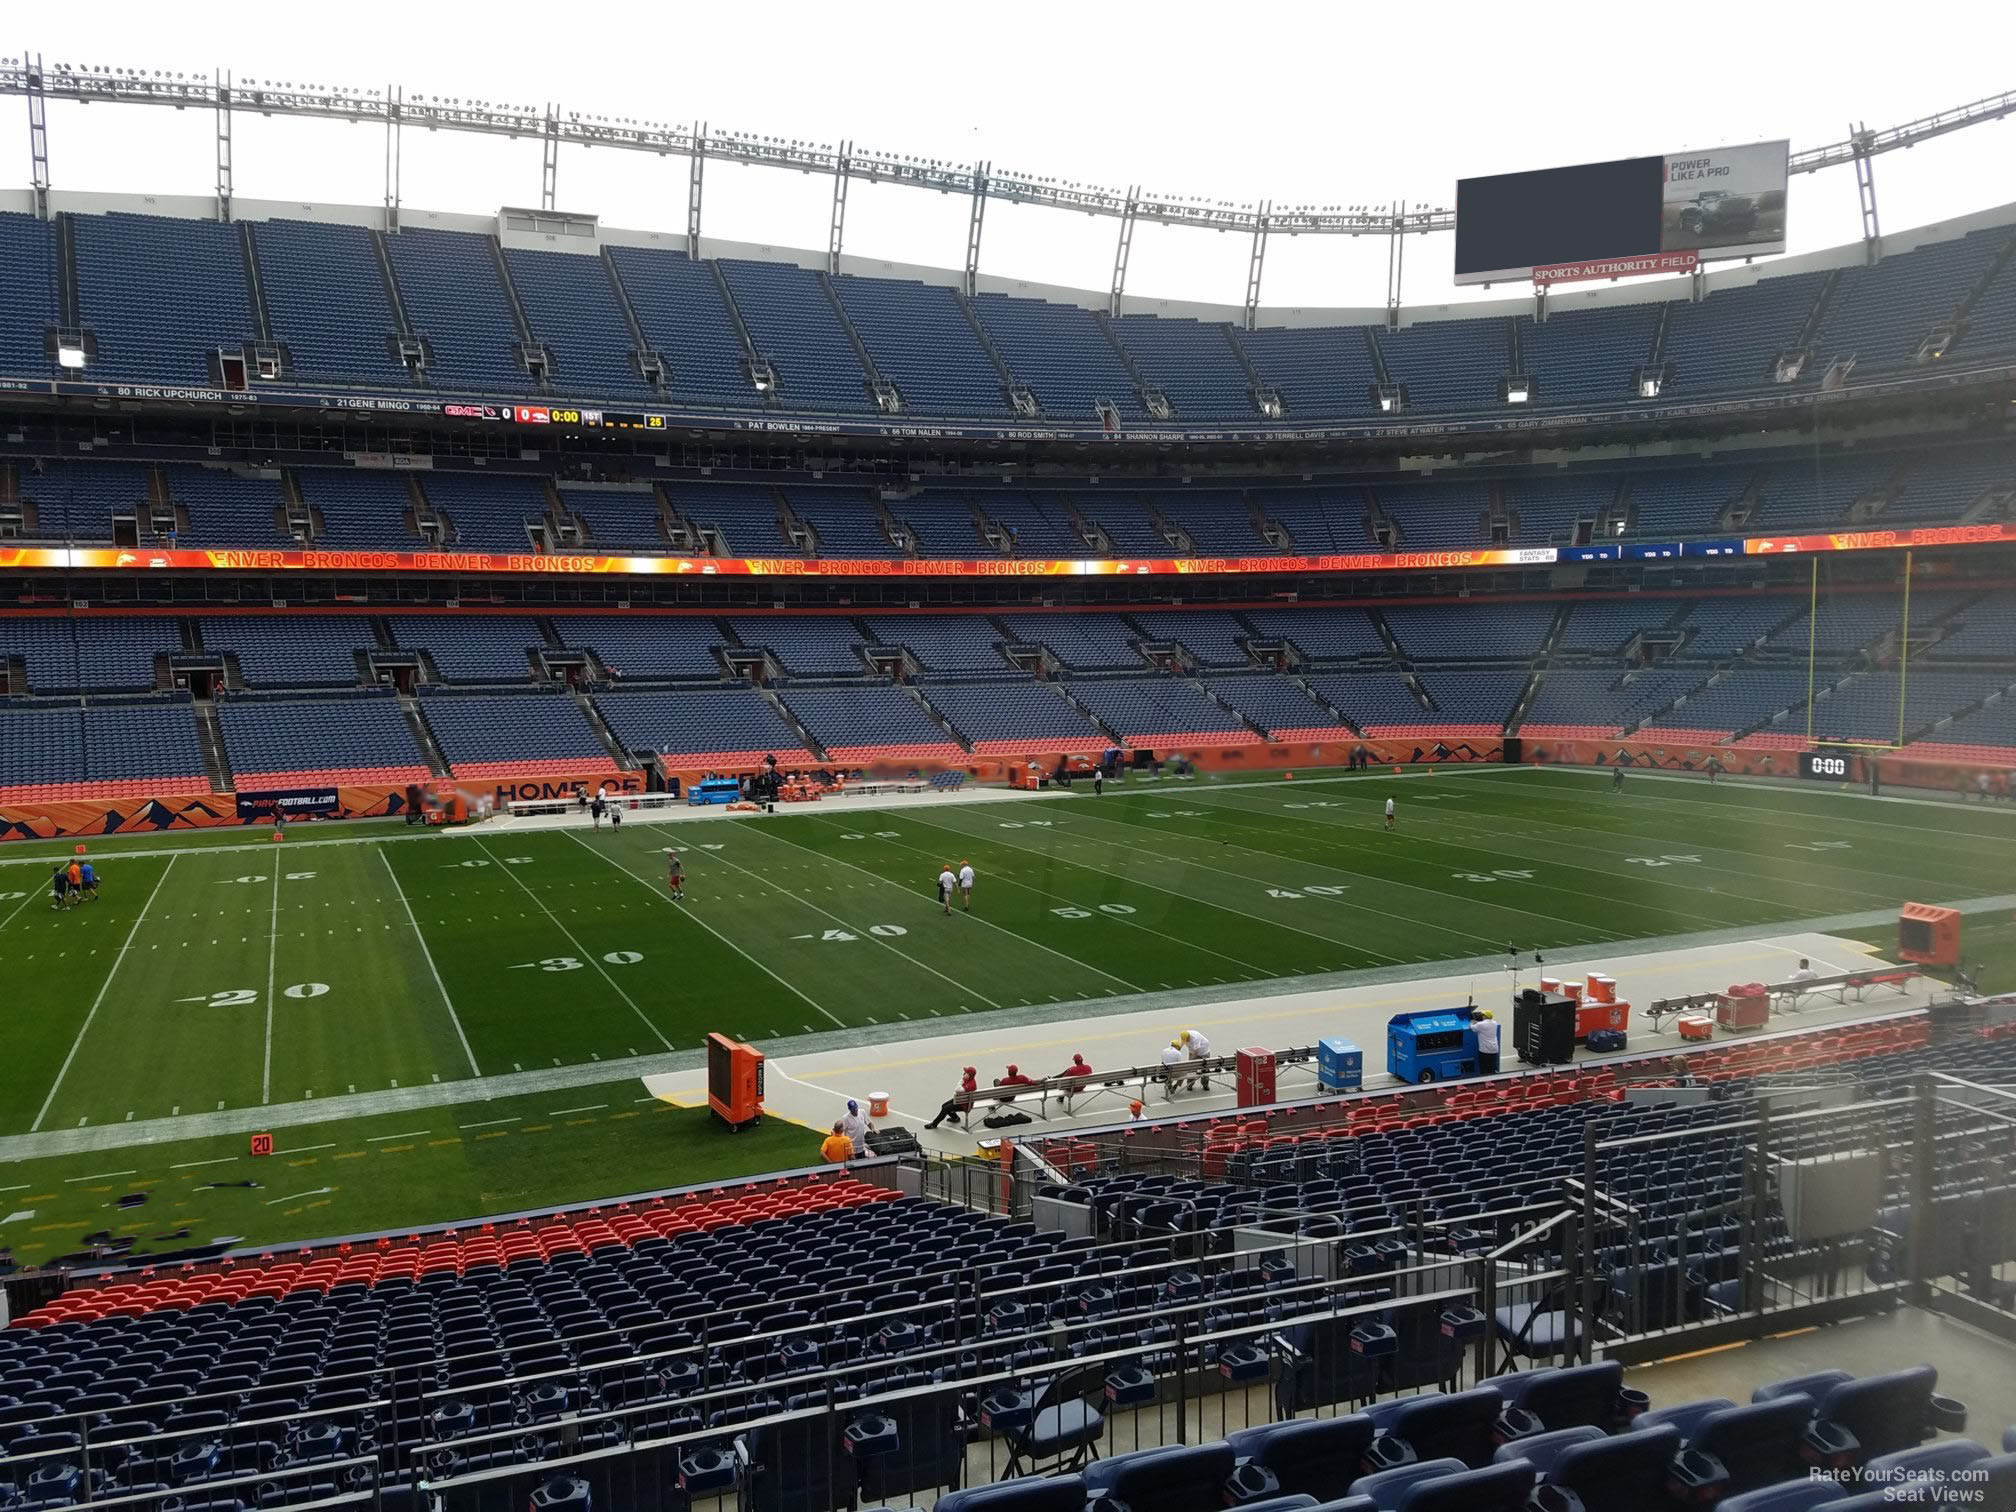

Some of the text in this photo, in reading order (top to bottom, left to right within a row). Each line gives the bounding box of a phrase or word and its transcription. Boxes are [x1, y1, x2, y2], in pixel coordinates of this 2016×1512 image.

[1671, 158, 1711, 172] POWER
[1671, 166, 1730, 182] LIKE A PRO
[1535, 255, 1696, 280] SPORTS AUTHORITY FIELD
[118, 387, 130, 396] 80
[135, 388, 161, 397] RICK
[163, 389, 222, 401] UPCHURCH
[336, 399, 349, 407] 21
[348, 399, 375, 408] GENE
[377, 400, 410, 410] MINGO
[445, 405, 483, 417] GMC
[502, 408, 511, 419] 0
[521, 409, 529, 419] 0
[552, 410, 579, 422] 0:00
[1667, 409, 1688, 417] KARL
[650, 418, 662, 426] 25
[748, 422, 764, 430] PAT
[767, 422, 800, 431] BOWLEN
[1541, 417, 1587, 426] ZIMMERMAN
[1386, 428, 1408, 436] STEVE
[1409, 426, 1445, 435] ATWATER
[1913, 525, 2003, 544] BRONCOS
[304, 552, 398, 568] BRONCOS
[415, 554, 491, 569] DENVER
[508, 555, 594, 571] BRONCOS
[819, 561, 892, 575] BRONCOS
[904, 561, 964, 575] DENVER
[977, 561, 1046, 575] BRONCOS
[1239, 557, 1307, 571] BRONCOS
[1320, 555, 1382, 570] DENVER
[1395, 552, 1473, 568] BRONCOS
[1812, 757, 1845, 775] 0:00
[496, 781, 590, 801] HOME
[1265, 885, 1346, 899] 40
[1050, 903, 1138, 919] 50
[821, 924, 909, 942] 40
[539, 948, 646, 971] 30
[208, 982, 331, 1007] 20
[254, 1136, 270, 1153] 20
